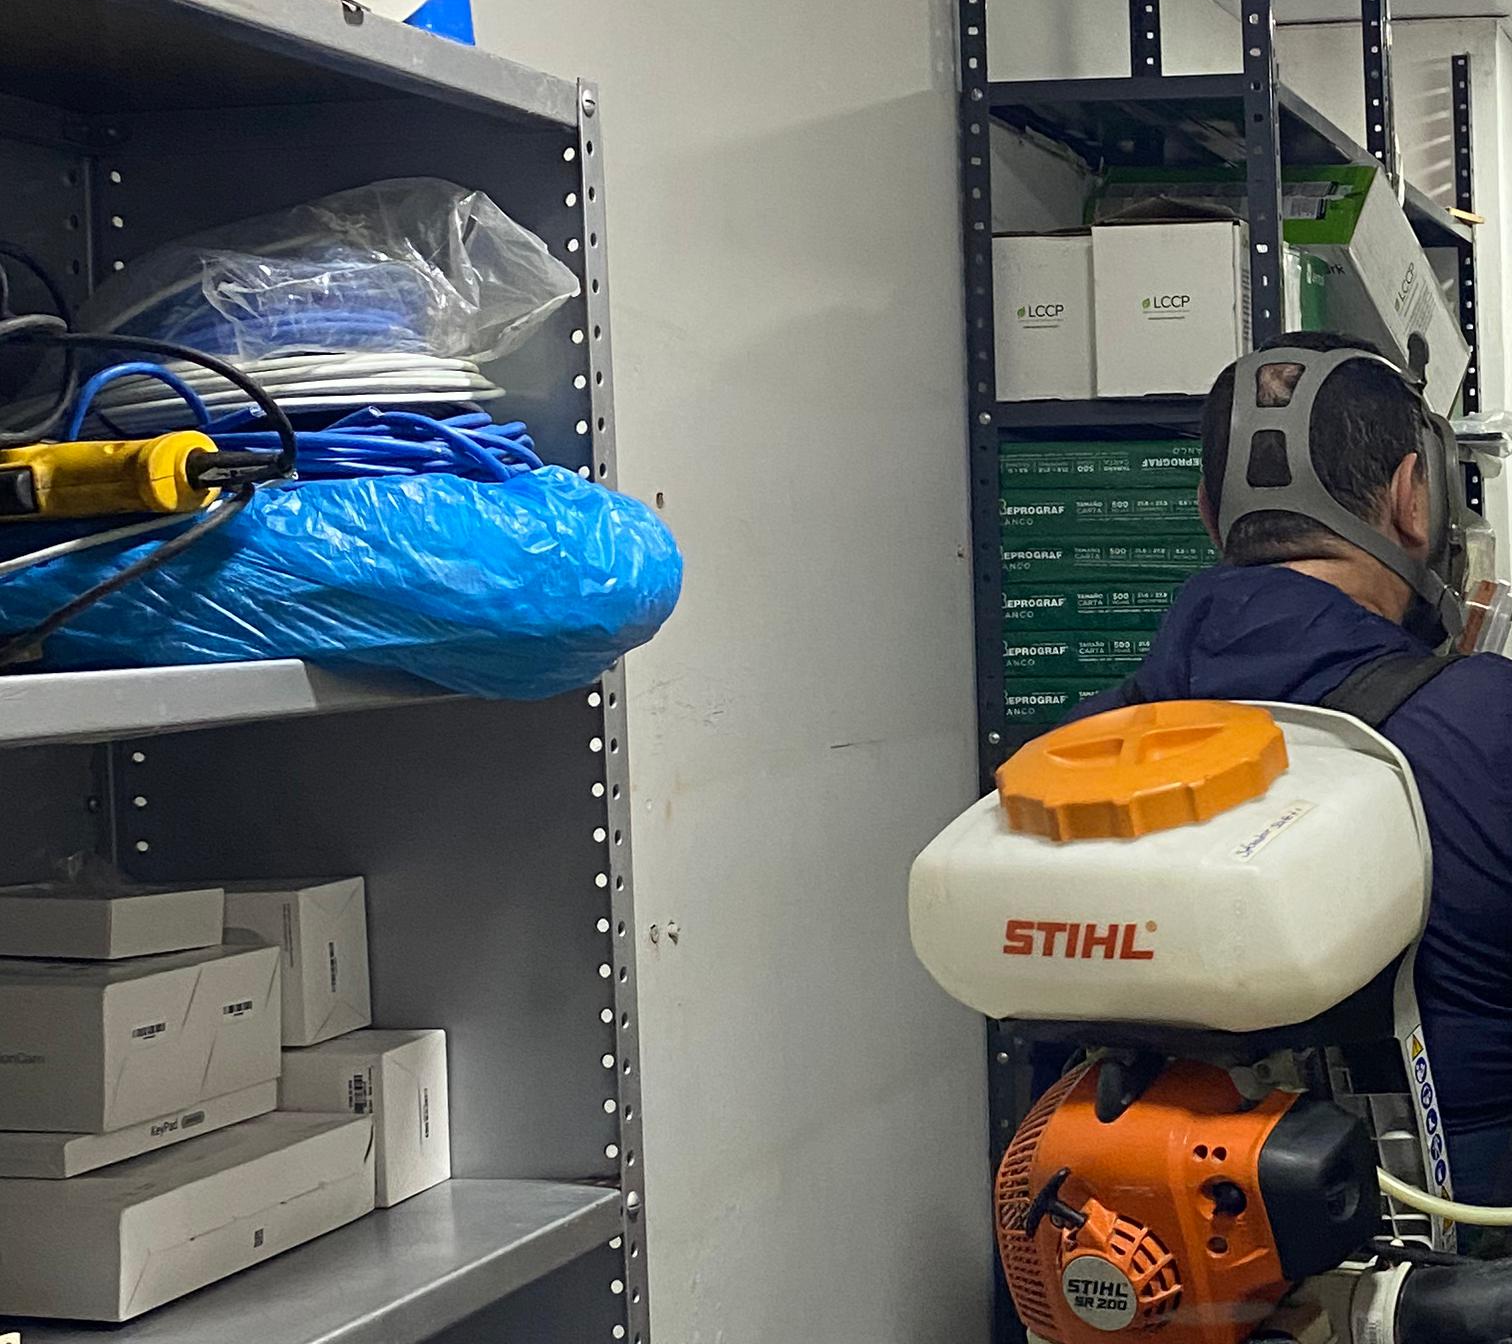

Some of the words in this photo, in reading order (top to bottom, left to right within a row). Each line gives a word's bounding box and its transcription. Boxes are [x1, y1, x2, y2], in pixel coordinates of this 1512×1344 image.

[1153, 295, 1191, 308] LCCP
[1028, 304, 1064, 318] LCCP
[1141, 457, 1203, 470] EPROGRAF
[1000, 500, 1065, 515] EPROGRAF
[1001, 548, 1063, 560] EPROGRAF
[1002, 562, 1031, 570] ANCO
[1002, 594, 1067, 608] EPROGRAF
[1003, 643, 1068, 656] EPROGRAF
[1006, 658, 1035, 666] ANCO
[1004, 693, 1068, 705] EPROGRAF
[1006, 707, 1035, 715] ANCO
[1003, 920, 1155, 960] STIHL
[151, 1118, 179, 1138] KeyPad
[1067, 1279, 1128, 1298] STIHL
[1074, 1295, 1095, 1308] SR
[1097, 1298, 1128, 1311] 200
